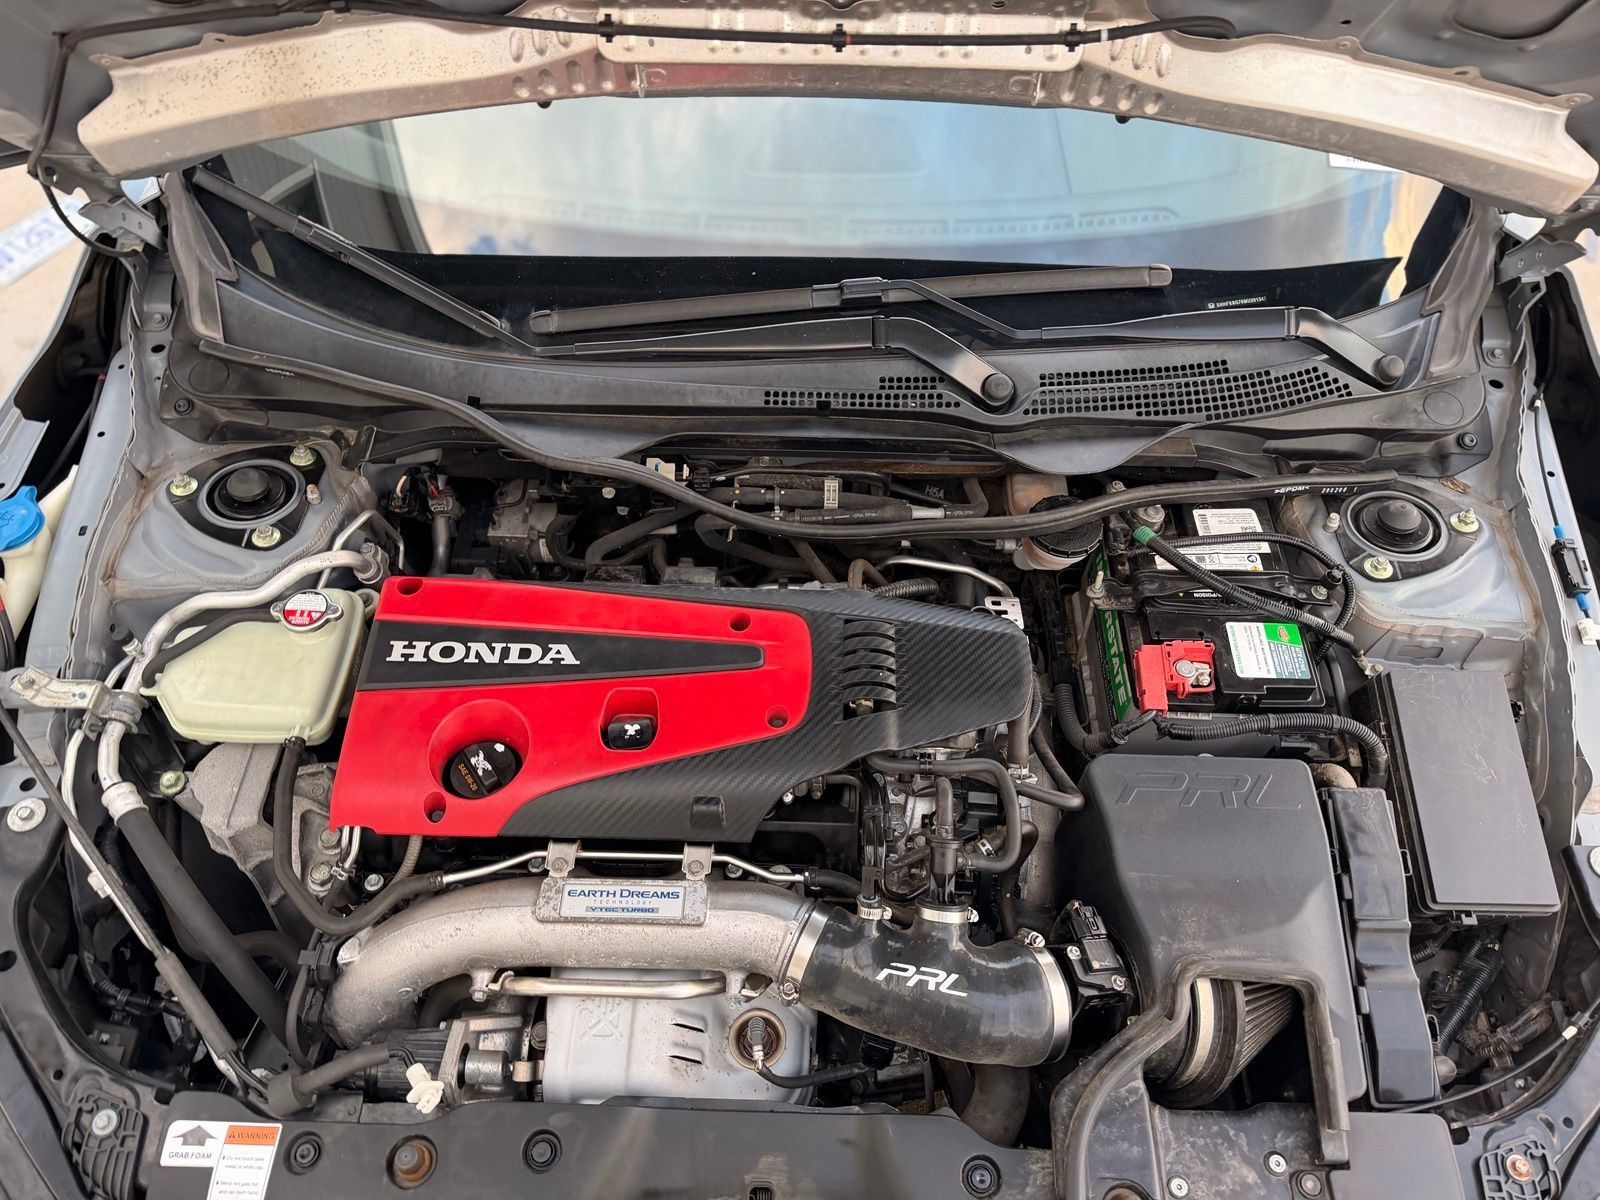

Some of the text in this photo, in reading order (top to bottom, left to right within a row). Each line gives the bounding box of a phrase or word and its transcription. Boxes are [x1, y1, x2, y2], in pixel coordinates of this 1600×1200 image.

[385, 640, 581, 665] HONDA
[458, 763, 477, 790] SAE 0W-20
[1115, 771, 1302, 810] PRL
[567, 888, 680, 899] EARTH DREAMS
[875, 962, 969, 997] PRL
[237, 1131, 275, 1140] WARNING
[168, 1151, 189, 1159] GRAB
